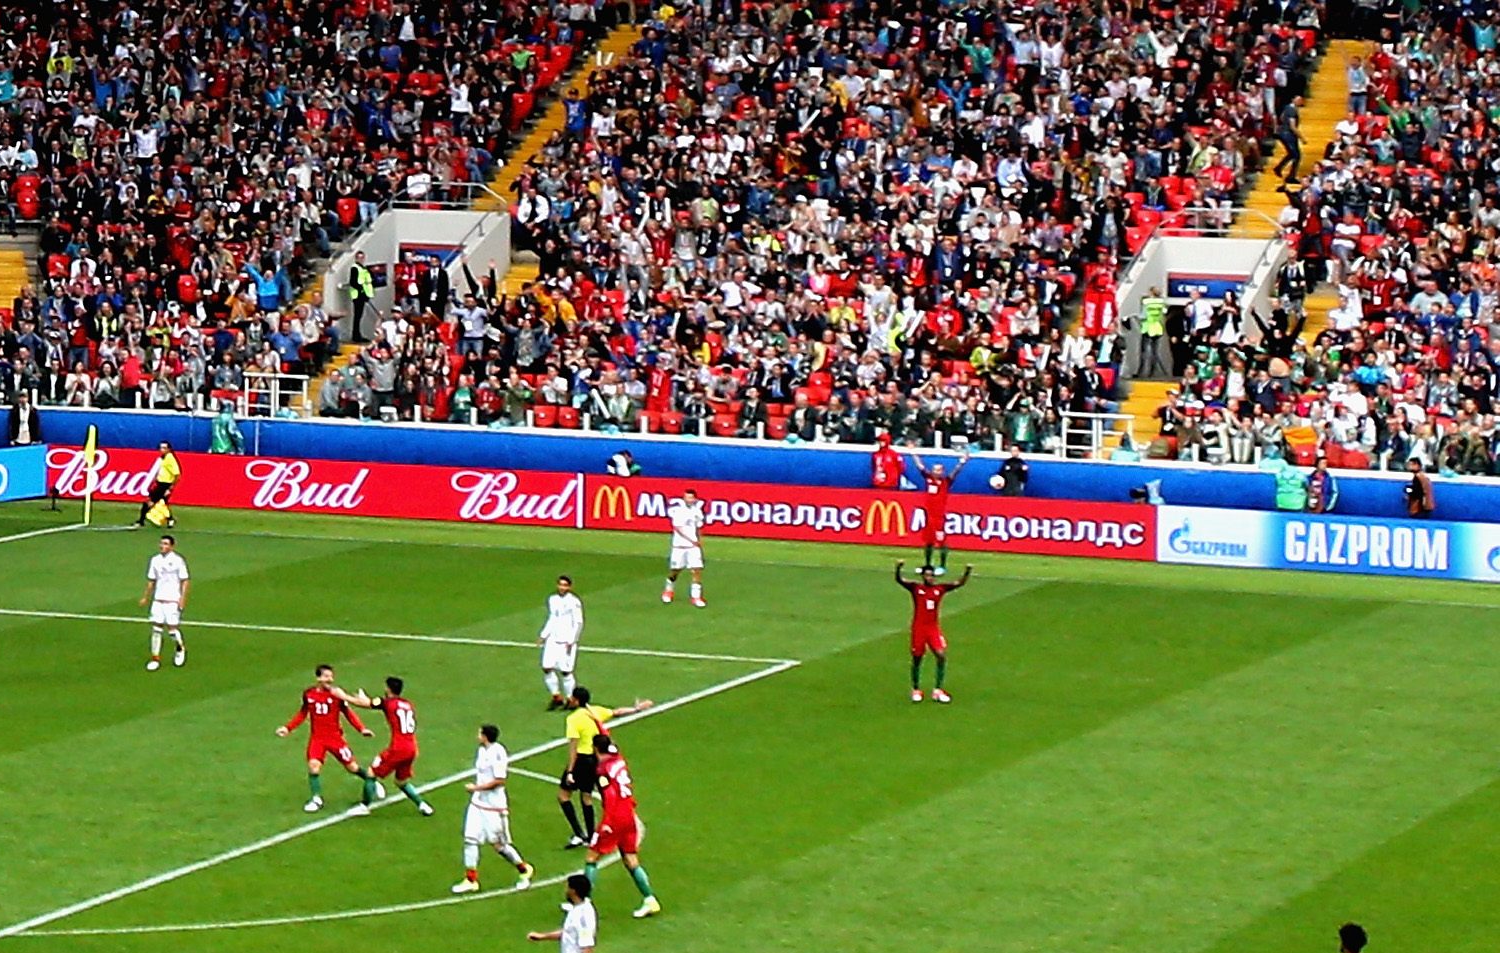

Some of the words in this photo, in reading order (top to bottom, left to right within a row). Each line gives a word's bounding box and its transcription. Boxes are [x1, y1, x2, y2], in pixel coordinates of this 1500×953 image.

[45, 448, 162, 496] Bud
[245, 460, 370, 509] Bud
[450, 470, 578, 520] Bud
[1285, 521, 1449, 571] GAZPROM
[396, 708, 416, 734] 16
